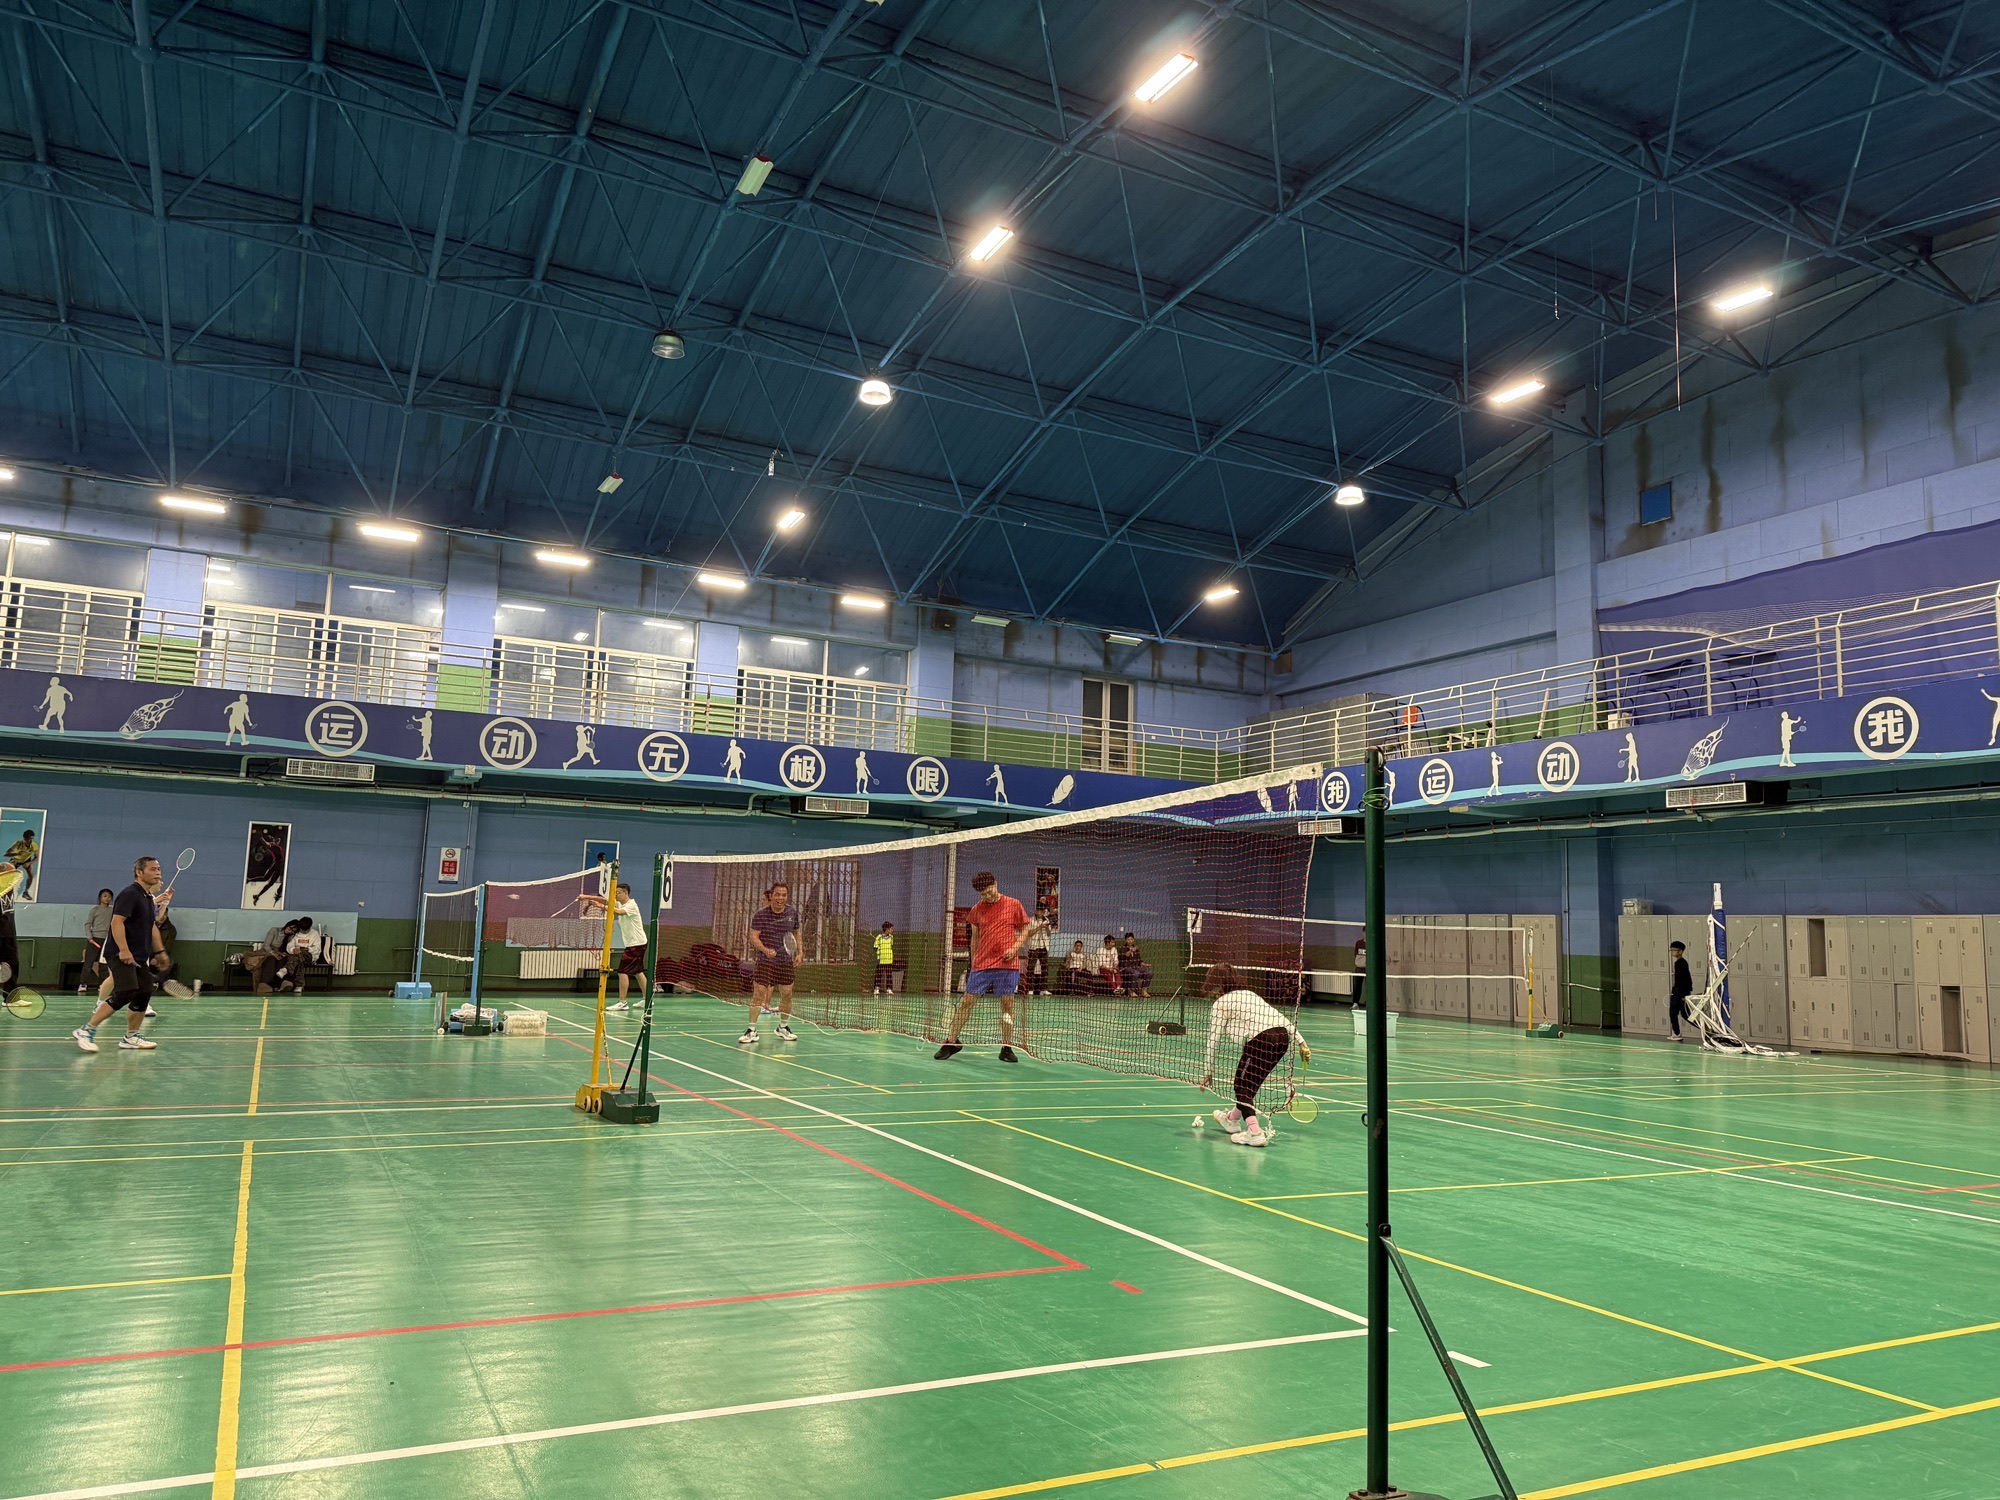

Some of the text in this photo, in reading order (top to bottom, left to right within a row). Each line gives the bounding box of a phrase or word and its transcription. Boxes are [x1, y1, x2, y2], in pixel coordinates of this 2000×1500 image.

[318, 712, 940, 793] 运 动 无 极 限
[1328, 708, 1905, 804] 我 运 动 我
[602, 869, 608, 894] 5
[663, 861, 672, 902] 6
[1190, 911, 1200, 929] 7
